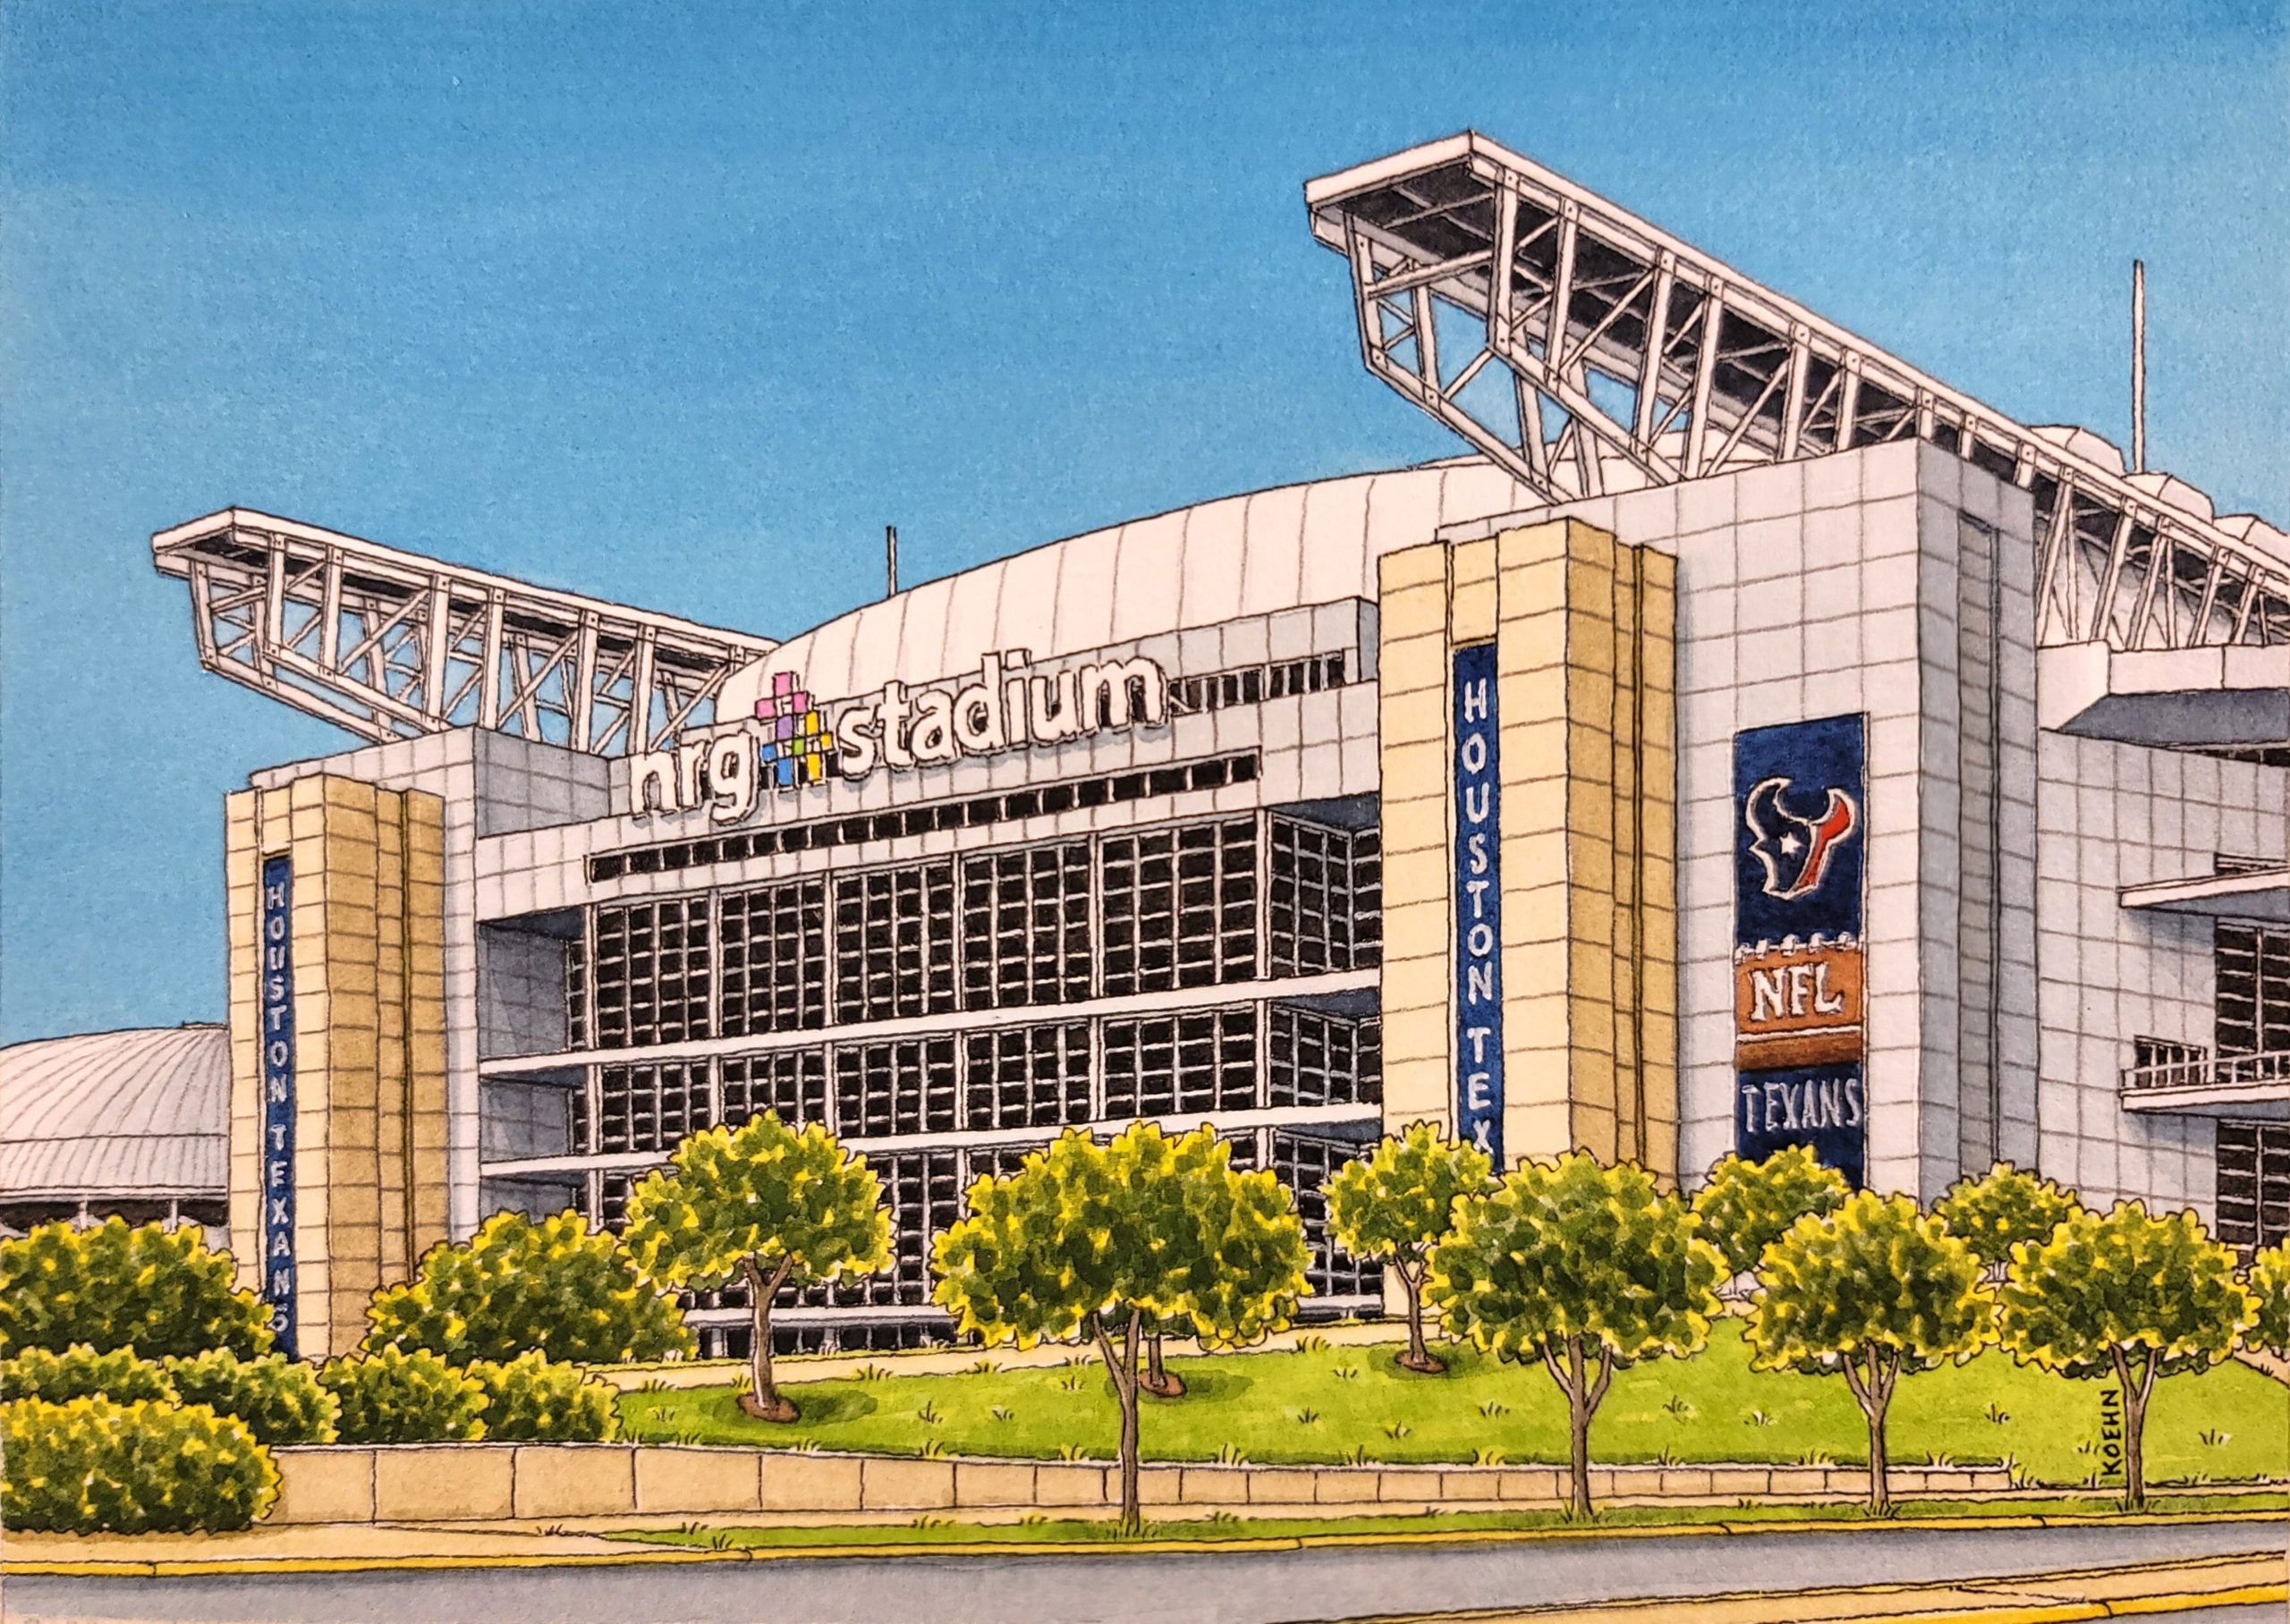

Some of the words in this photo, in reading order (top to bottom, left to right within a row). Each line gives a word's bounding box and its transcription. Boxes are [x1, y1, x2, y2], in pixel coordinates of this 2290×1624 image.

[629, 730, 760, 825] nrg
[836, 648, 1168, 781] stadium
[1461, 677, 1493, 1006] HOUSTON
[266, 881, 291, 1104] HOUSTON
[1747, 960, 1845, 1022] NFL
[1466, 1027, 1495, 1155] TEX
[1741, 1077, 1863, 1133] TEXANS
[267, 1121, 292, 1333] TEXANS
[2099, 1389, 2123, 1476] KOEHN
